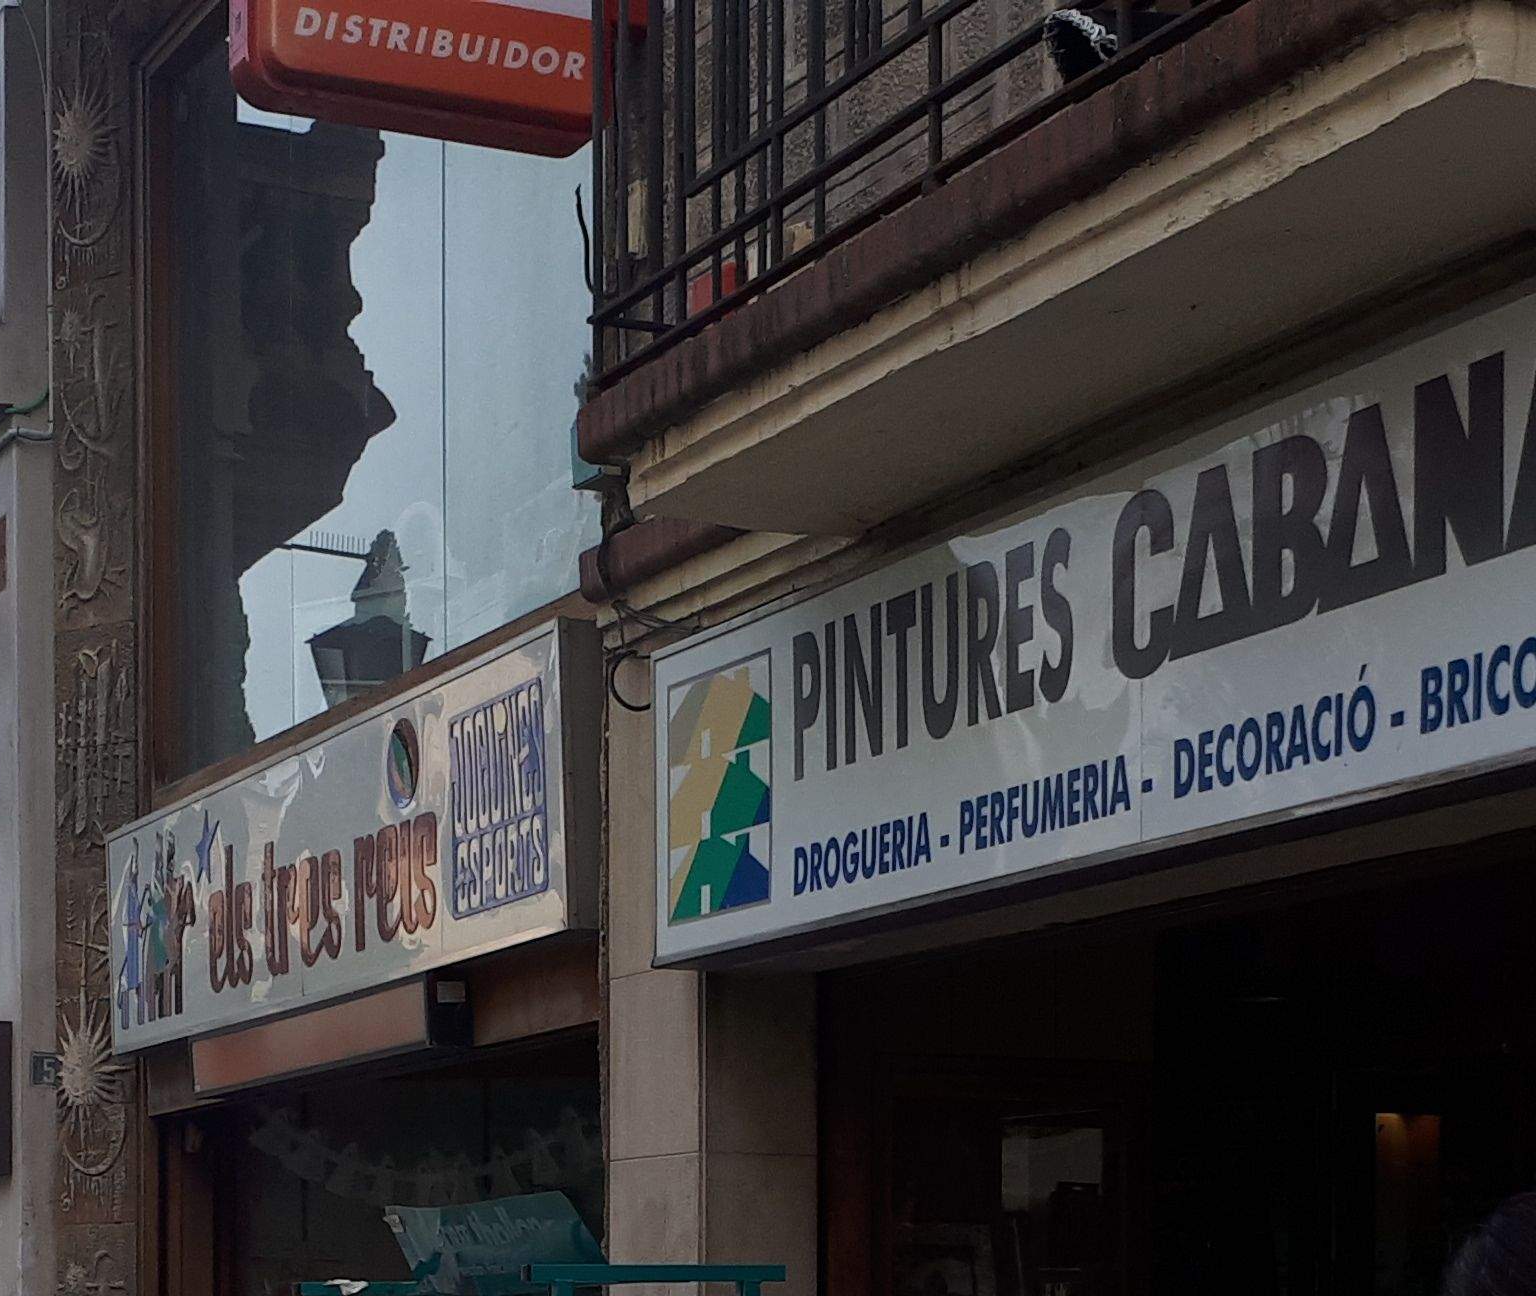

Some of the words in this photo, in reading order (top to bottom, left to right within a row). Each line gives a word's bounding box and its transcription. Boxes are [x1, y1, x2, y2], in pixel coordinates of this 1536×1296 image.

[294, 6, 586, 81] DISTRIBUIDOR
[792, 527, 1074, 782] PINTURES
[793, 812, 932, 897] DROGUERIA
[958, 754, 1133, 856] PERFUMERIA
[1172, 664, 1377, 799] DECORACIÓ
[208, 844, 253, 994] els
[264, 840, 343, 977] tres
[353, 811, 438, 953] reis
